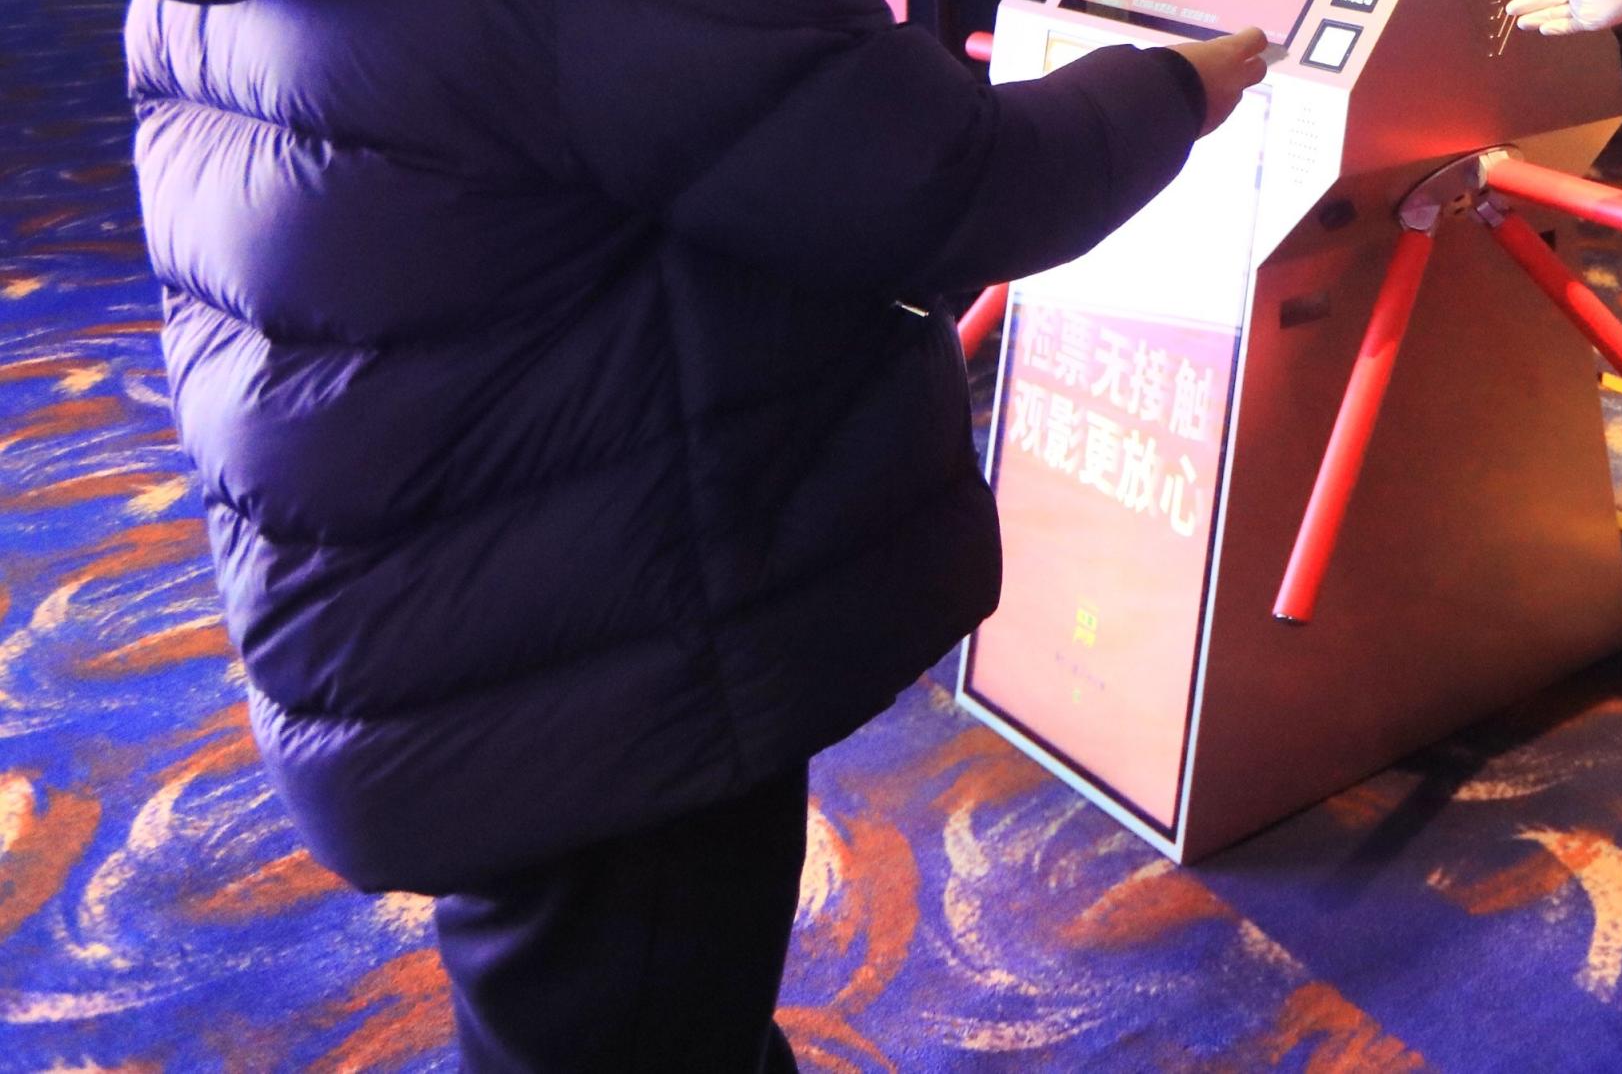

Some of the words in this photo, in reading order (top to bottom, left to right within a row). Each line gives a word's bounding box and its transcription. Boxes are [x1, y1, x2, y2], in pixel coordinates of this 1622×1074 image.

[1008, 378, 1205, 538] 观影更放心
